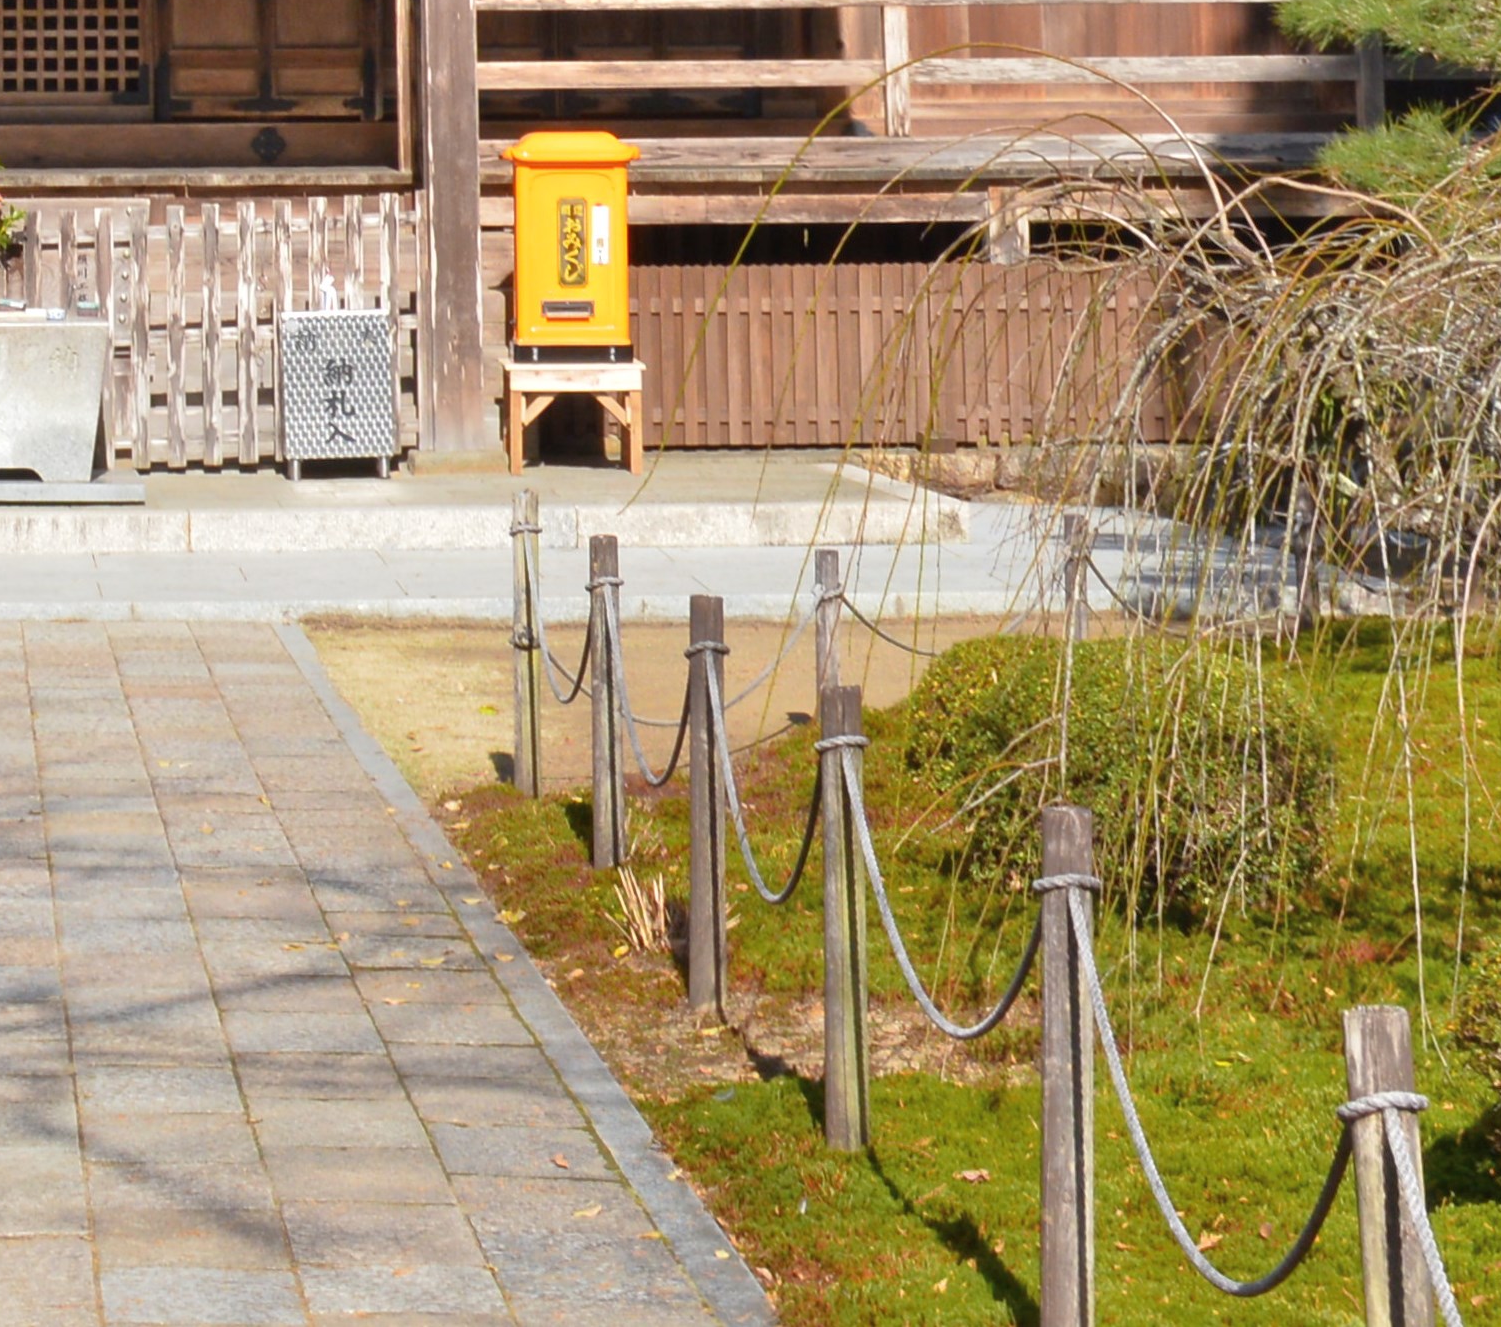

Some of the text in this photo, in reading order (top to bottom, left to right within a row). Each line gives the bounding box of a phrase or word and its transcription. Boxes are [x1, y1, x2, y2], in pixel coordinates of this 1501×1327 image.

[562, 217, 584, 283] おみくじ
[322, 358, 357, 444] 納札入
